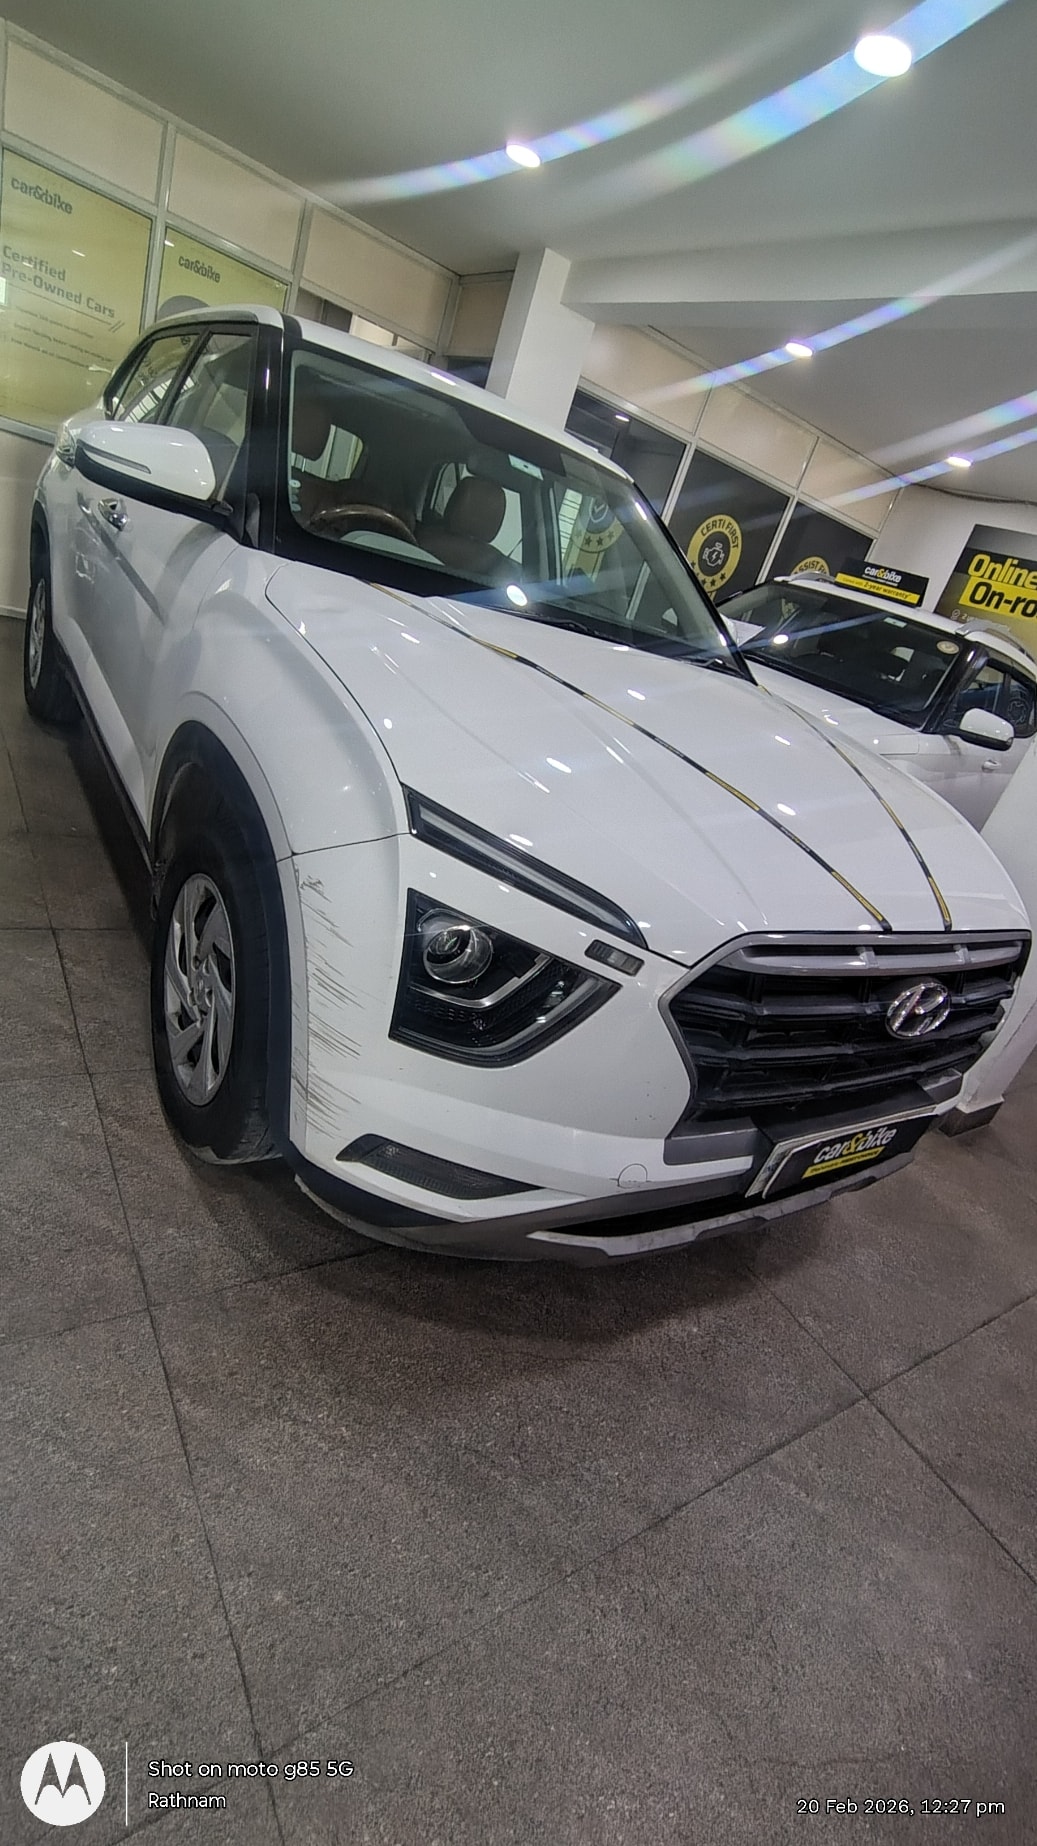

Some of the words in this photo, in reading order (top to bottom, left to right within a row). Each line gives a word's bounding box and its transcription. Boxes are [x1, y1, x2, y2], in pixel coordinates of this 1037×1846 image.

[11, 177, 73, 215] car&bike
[3, 245, 66, 281] Certified
[178, 255, 221, 283] car&bike
[1, 261, 82, 305] Pre-Owned
[86, 297, 115, 318] Cars
[700, 518, 725, 537] CERTI
[725, 521, 739, 549] FIRST
[863, 581, 883, 592] 2-year
[864, 566, 902, 583] car&bike
[968, 553, 1037, 590] Online
[969, 581, 1037, 618] On-ro
[813, 1126, 898, 1164] car&bike
